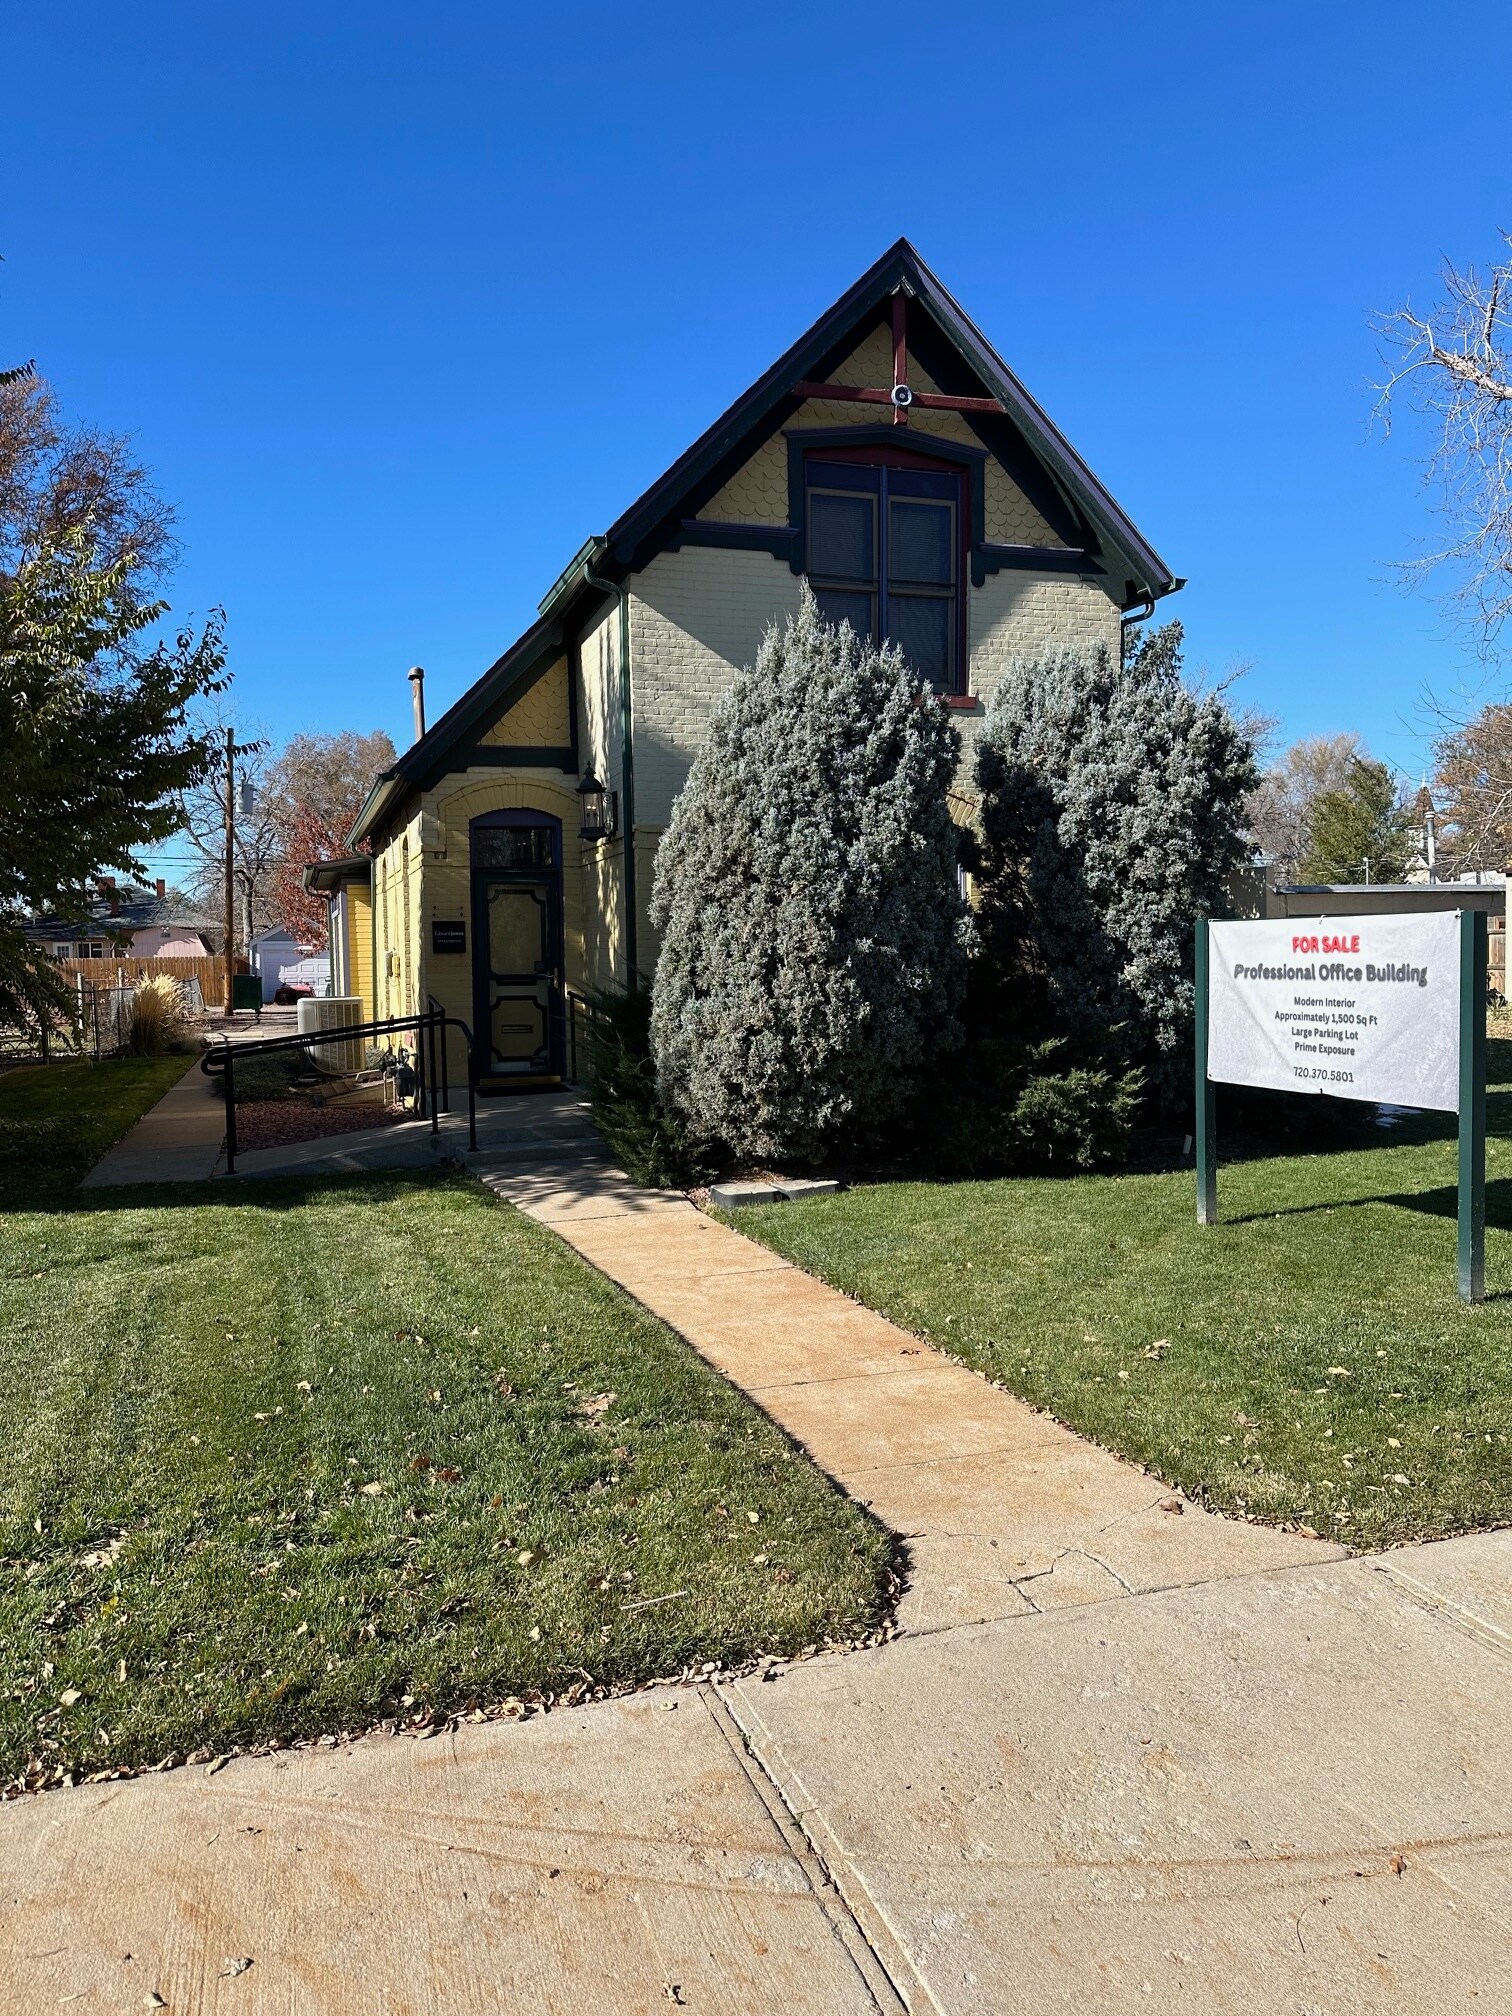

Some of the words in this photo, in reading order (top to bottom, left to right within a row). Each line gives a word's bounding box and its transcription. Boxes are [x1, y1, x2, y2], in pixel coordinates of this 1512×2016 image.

[1292, 936, 1319, 953] FOR
[1322, 935, 1360, 953] SALE
[1234, 963, 1316, 980] Professional
[1319, 963, 1362, 981] Office
[1366, 964, 1428, 986] Building
[1294, 996, 1324, 1007] Modern
[1325, 998, 1356, 1008] Interior
[1275, 1010, 1331, 1024] Approximately
[1332, 1014, 1354, 1024] 1,500
[1356, 1015, 1367, 1026] Sq
[1369, 1015, 1378, 1025] Ft
[1291, 1027, 1312, 1038] Large
[1314, 1028, 1343, 1041] Parking
[1345, 1030, 1358, 1040] Lot
[1294, 1042, 1317, 1053] Prime
[1319, 1044, 1355, 1056] Exposure
[1293, 1066, 1354, 1082] 720.370.5801
